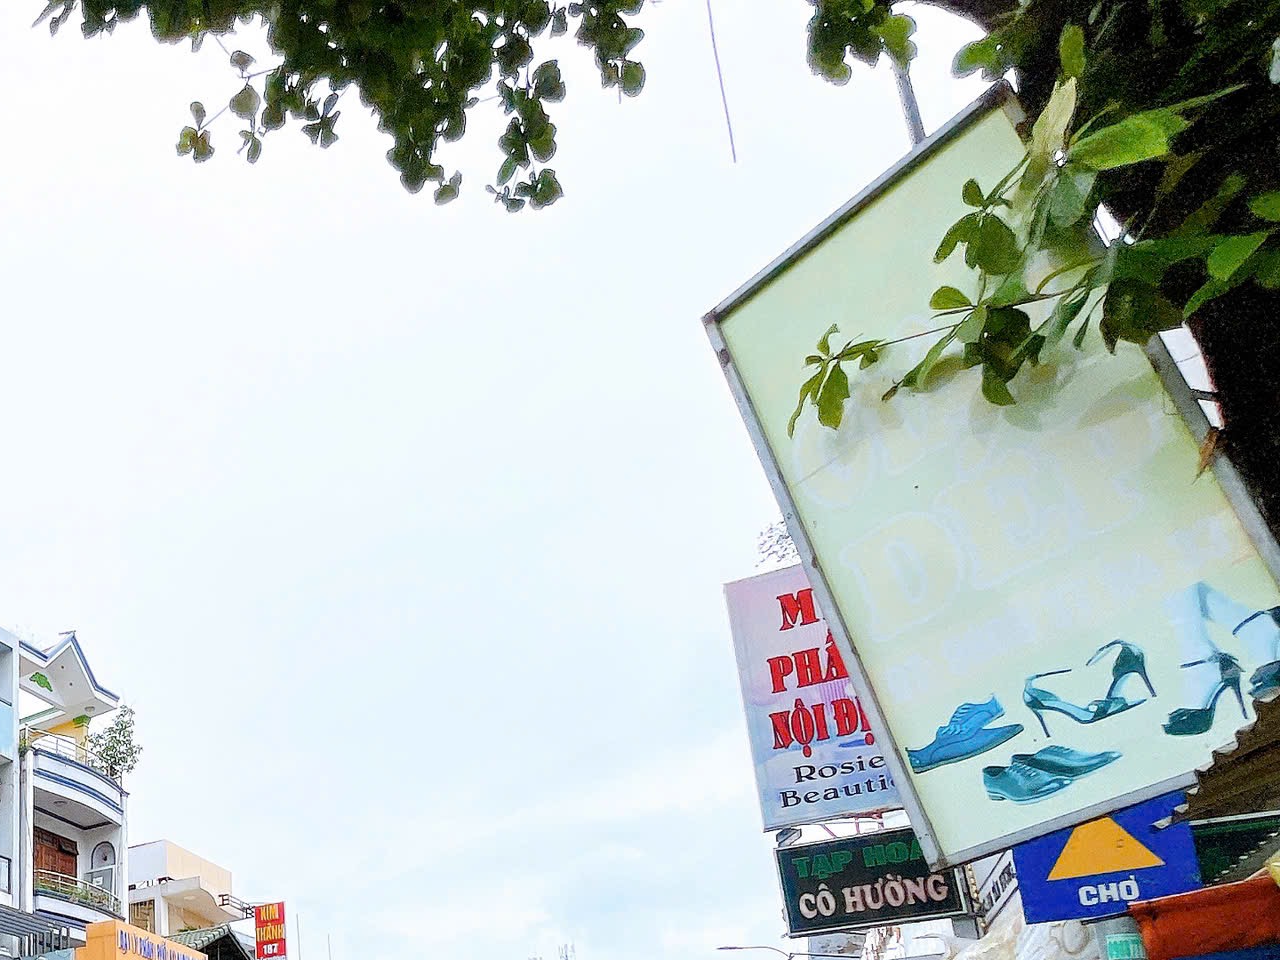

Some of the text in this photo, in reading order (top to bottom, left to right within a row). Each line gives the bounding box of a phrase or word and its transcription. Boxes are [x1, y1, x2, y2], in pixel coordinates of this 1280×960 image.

[769, 698, 830, 758] NỘI
[793, 755, 886, 784] Rosie
[780, 774, 896, 808] Beauti
[792, 850, 853, 880] TẠP
[799, 882, 836, 919] CÔ
[841, 874, 949, 914] HƯỜNG
[260, 903, 279, 921] KIM
[262, 943, 279, 955] 187
